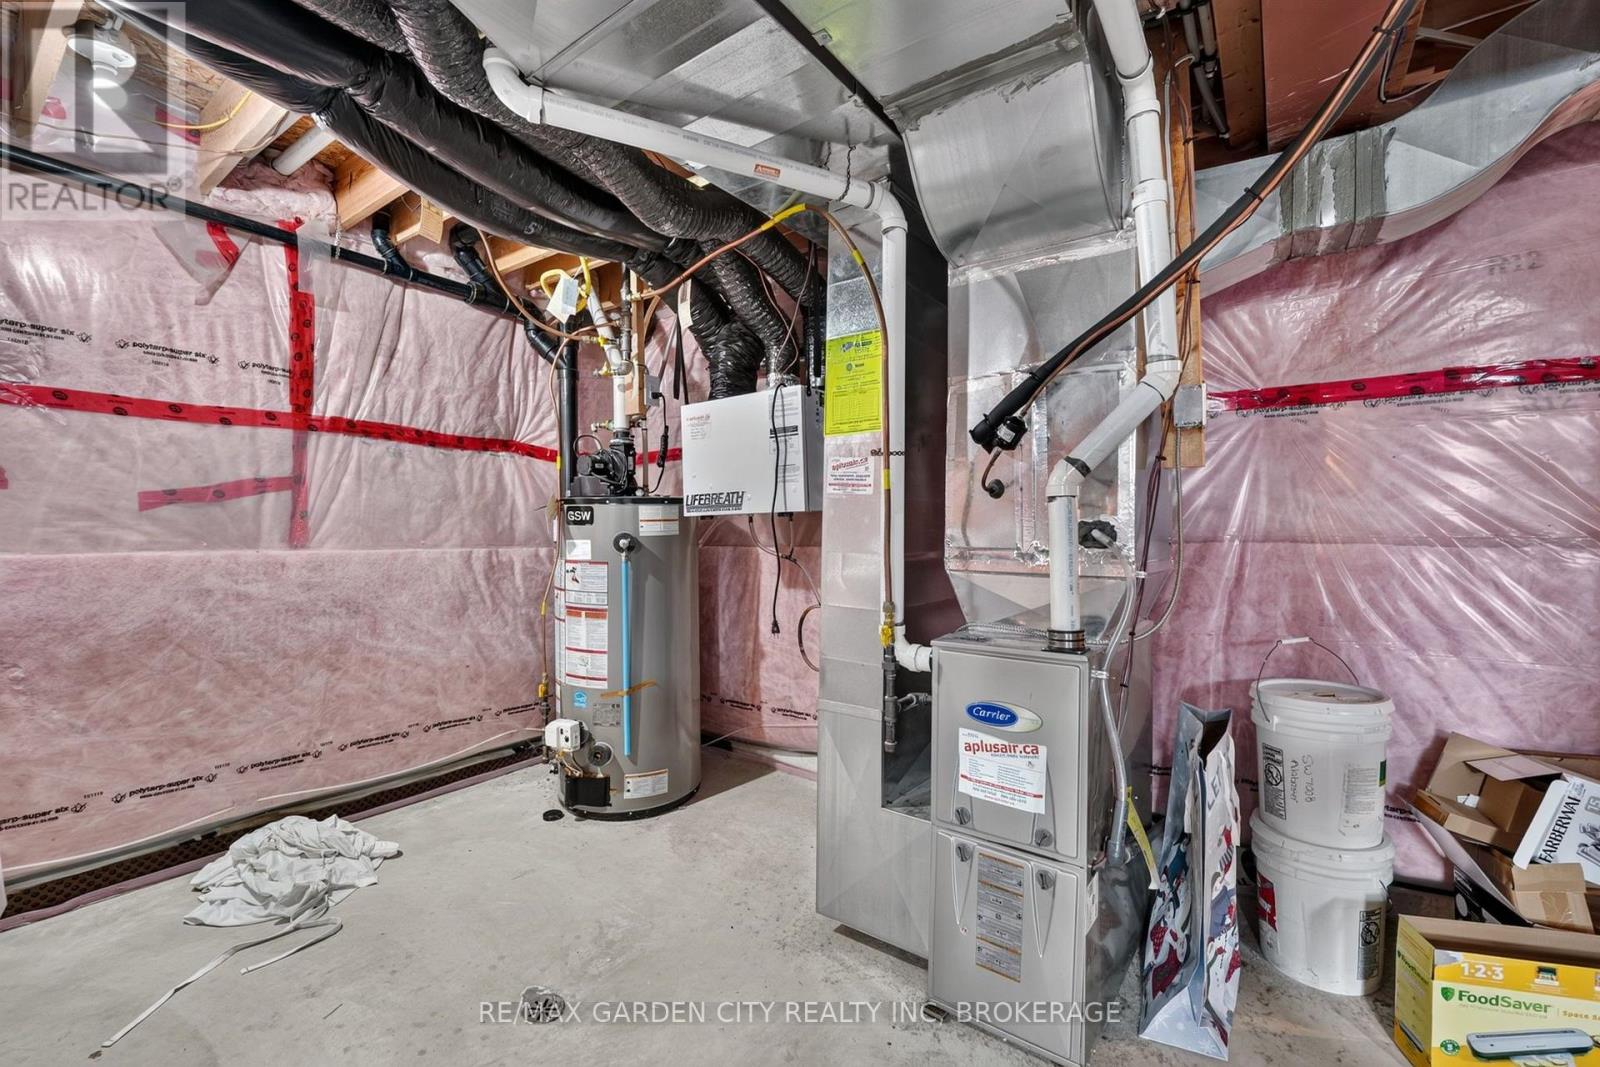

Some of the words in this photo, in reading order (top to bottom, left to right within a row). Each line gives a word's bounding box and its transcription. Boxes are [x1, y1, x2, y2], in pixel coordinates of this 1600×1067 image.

[686, 491, 745, 506] LIFEBREATH
[567, 510, 592, 521] GSW
[972, 706, 1011, 721] Carrier
[964, 739, 1039, 755] aplusair.ca
[1458, 989, 1553, 1014] FoodSaver
